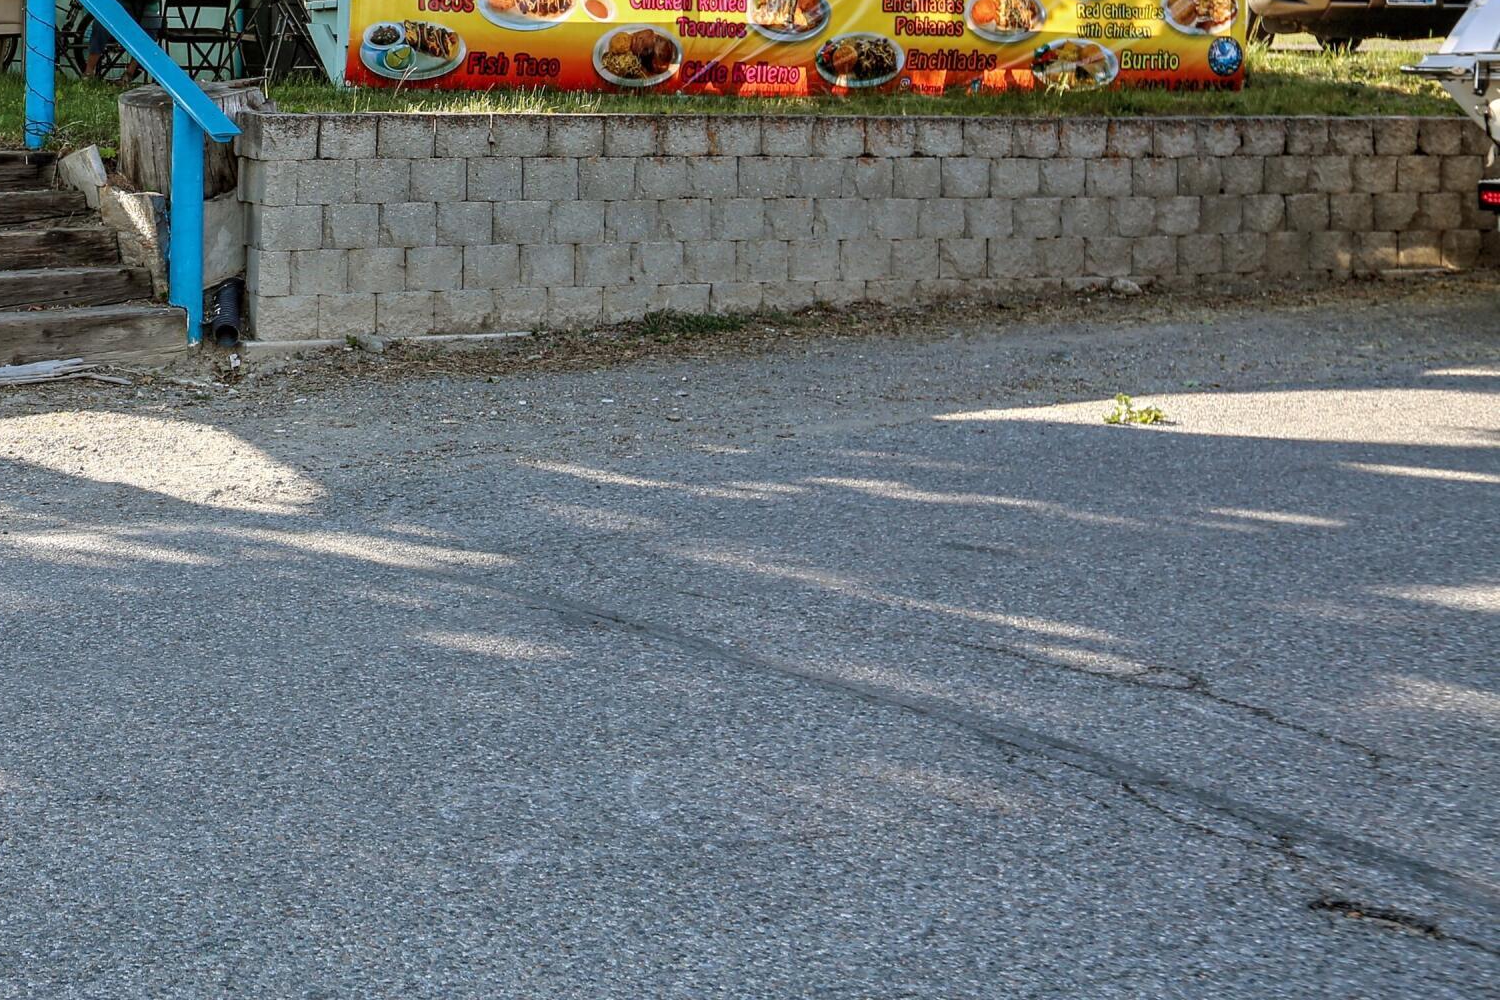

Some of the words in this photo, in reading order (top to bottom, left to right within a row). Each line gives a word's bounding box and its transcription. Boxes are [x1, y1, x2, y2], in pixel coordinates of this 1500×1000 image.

[1076, 3, 1100, 19] Red
[1103, 4, 1165, 21] Chilaquiles
[676, 16, 747, 38] Taquitos
[895, 15, 964, 37] Poblanas
[1077, 24, 1101, 38] with
[1104, 24, 1151, 39] Chicken
[466, 51, 509, 76] Fish
[513, 53, 561, 78] Taco
[906, 49, 997, 71] Enchiladas
[1120, 50, 1180, 70] Burrito
[681, 60, 728, 83] Chile
[731, 62, 800, 85] Relleno
